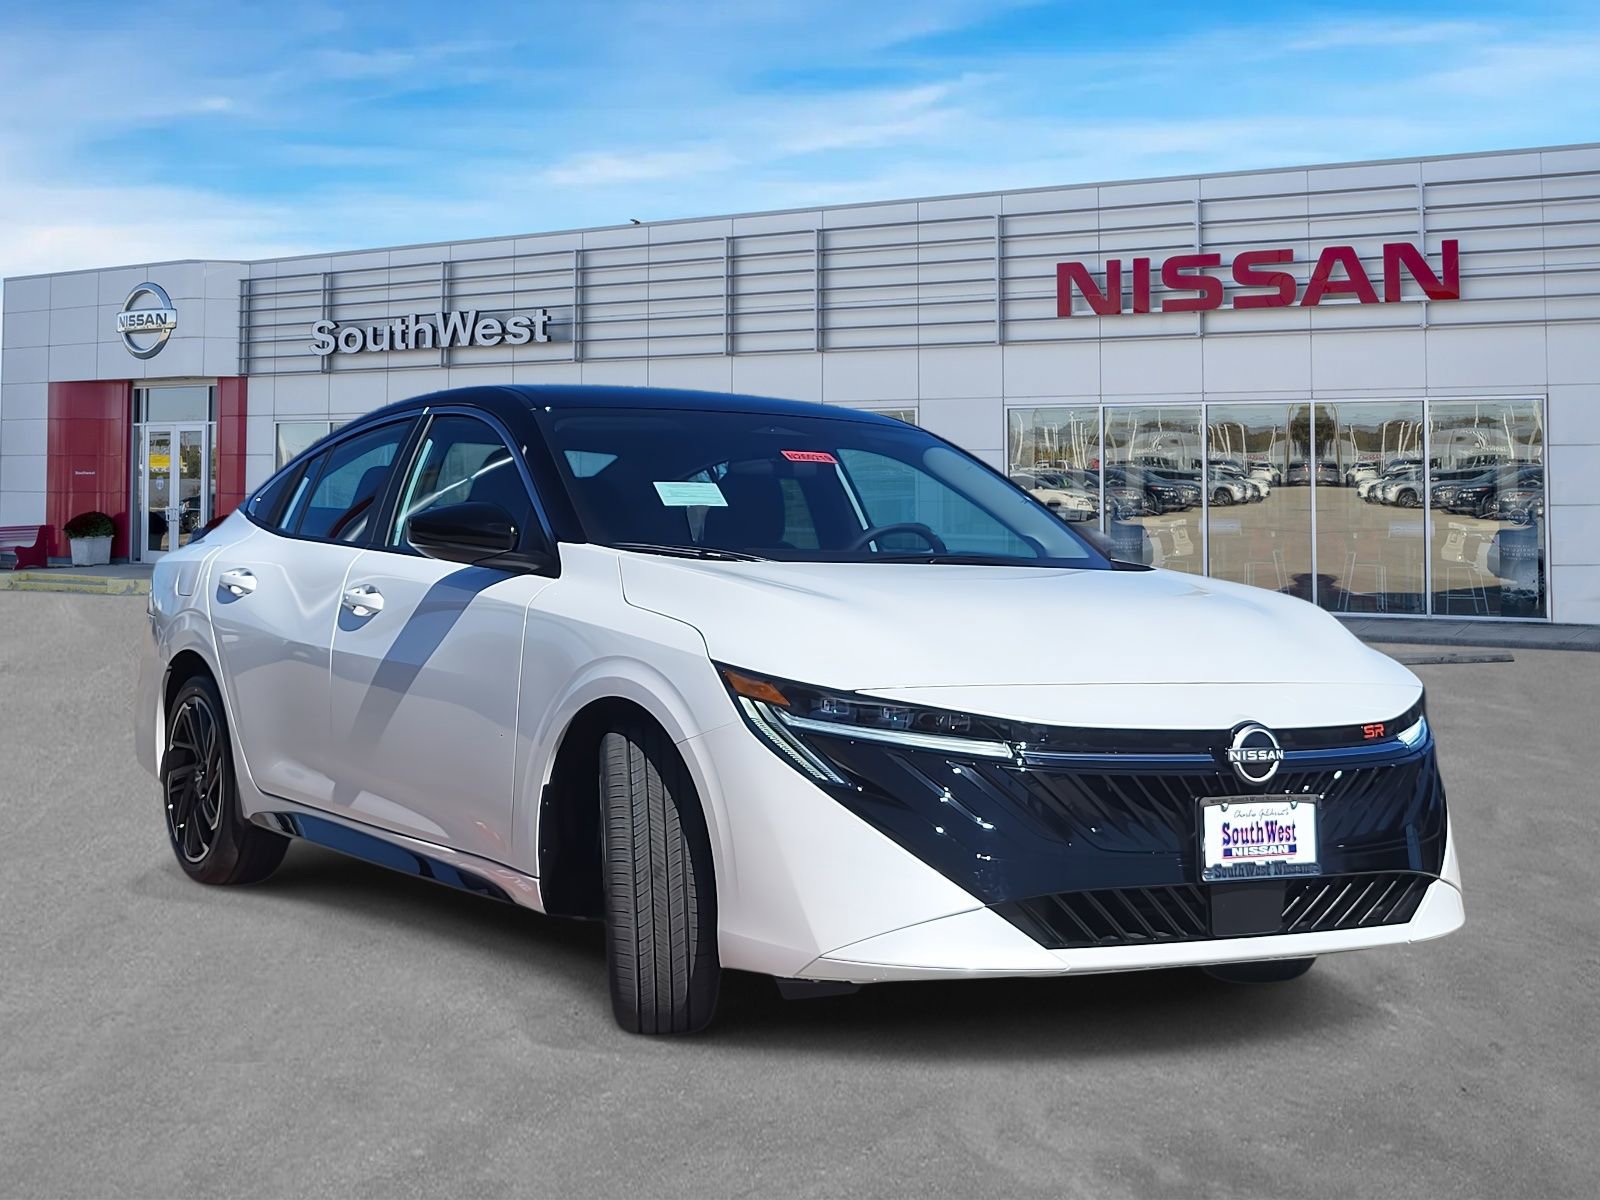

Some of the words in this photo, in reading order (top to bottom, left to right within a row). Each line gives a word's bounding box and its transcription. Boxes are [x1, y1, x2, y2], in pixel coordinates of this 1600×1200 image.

[1056, 239, 1460, 317] NISSAN
[119, 312, 167, 328] NISSAN
[311, 308, 552, 357] SouthWest
[1363, 723, 1386, 740] SR
[1228, 749, 1285, 762] NISSAN
[1231, 845, 1289, 857] NISSAN
